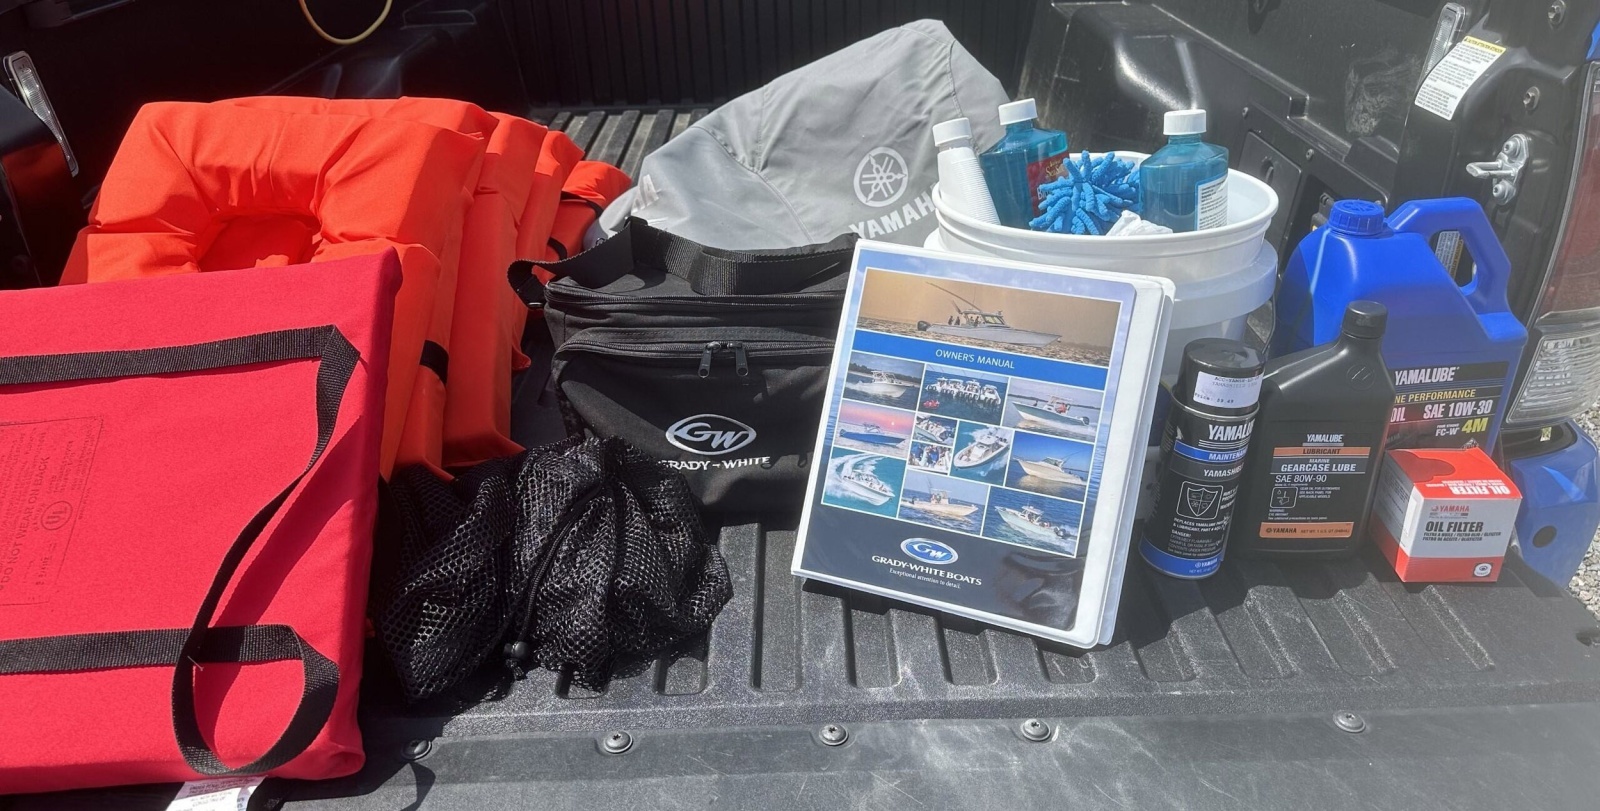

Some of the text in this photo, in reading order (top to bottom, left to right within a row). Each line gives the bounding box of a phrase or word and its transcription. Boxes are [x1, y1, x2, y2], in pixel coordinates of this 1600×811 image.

[848, 182, 936, 239] YAMAH
[936, 349, 1015, 369] OWNER'S MANUAL
[1394, 366, 1456, 386] YAMALUBE
[1408, 388, 1476, 402] PERFORMANCE
[1390, 400, 1494, 422] OIL SAE 10W-30
[1461, 418, 1488, 434] 4M
[1307, 434, 1344, 442] YAMALUBE
[35, 456, 50, 485] BACK
[722, 456, 770, 469] WHITE
[1281, 464, 1356, 472] GEARCASE LUBE
[1275, 475, 1292, 483] SAE
[28, 490, 40, 507] ON
[1449, 486, 1511, 494] OIL FILTER
[16, 506, 34, 541] WEAR
[1425, 521, 1484, 532] OIL FILTER
[11, 542, 23, 564] NOT
[912, 542, 950, 559] GW
[3, 567, 14, 584] DO
[872, 555, 982, 586] GRADY-WHITE BOATS
[889, 568, 917, 579] Exceptional
[917, 576, 939, 584] attention
